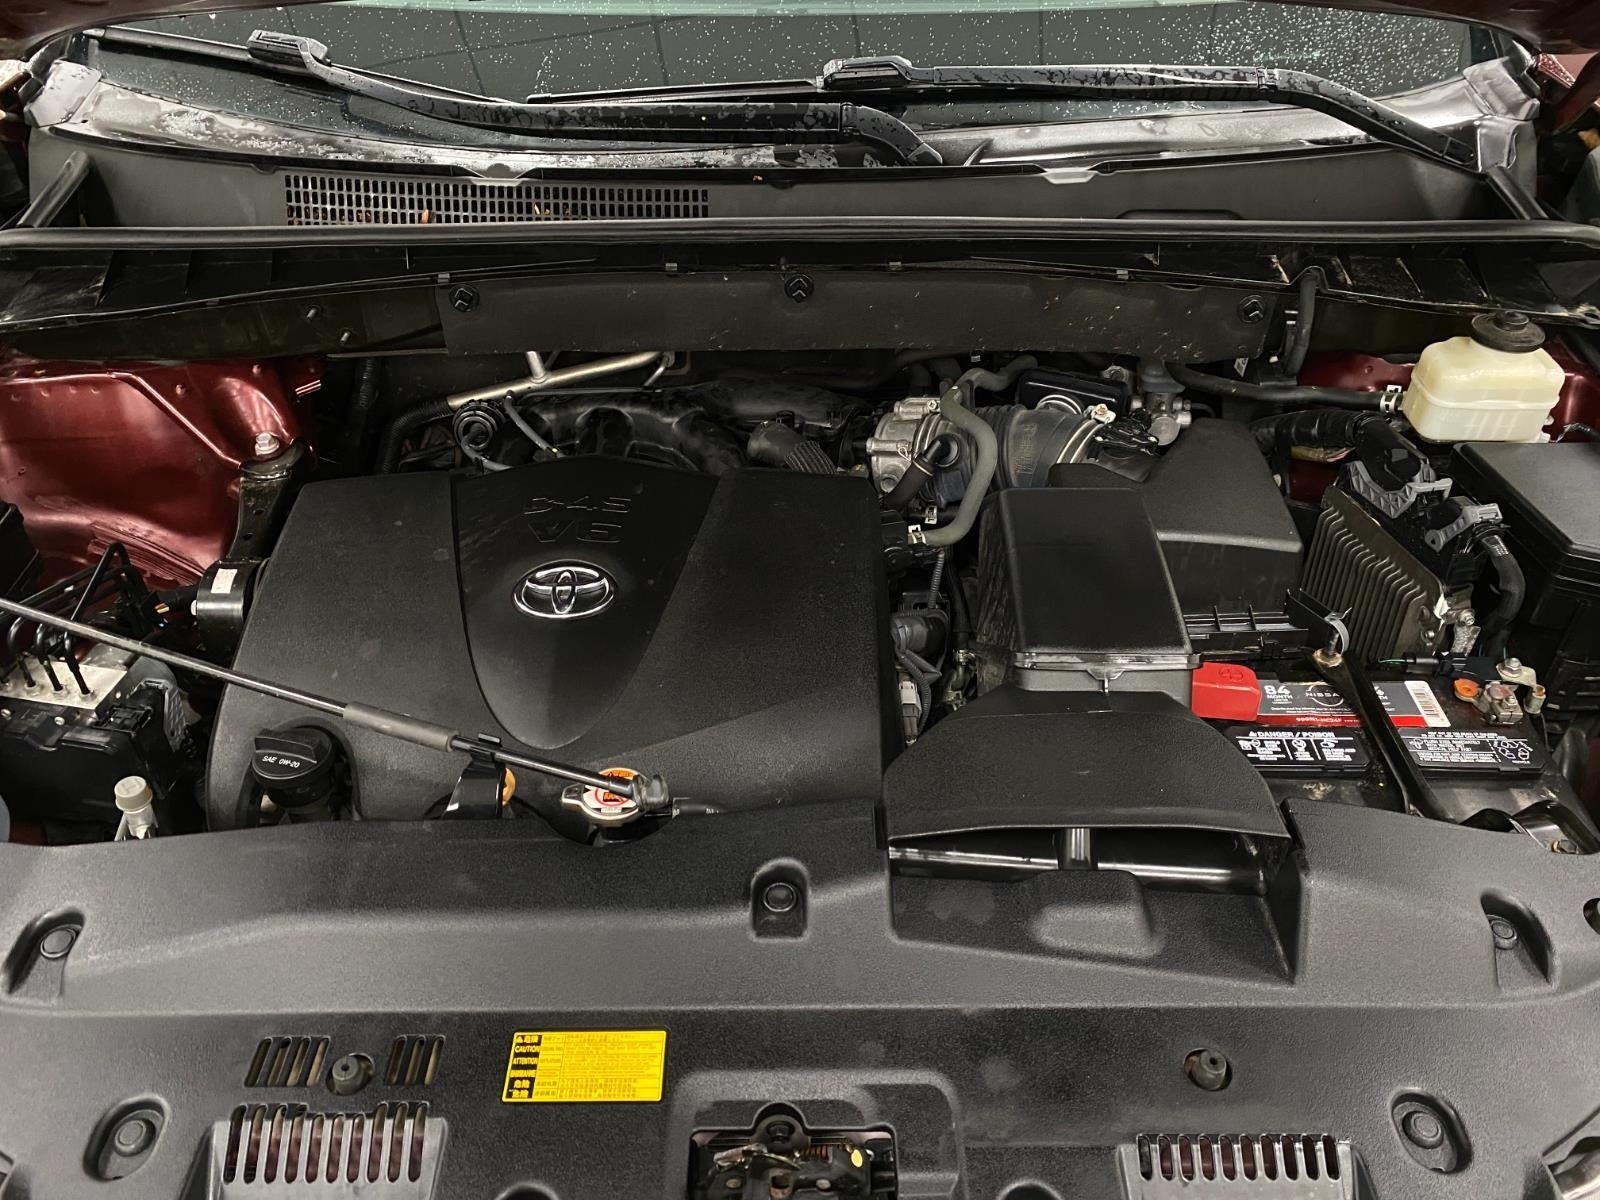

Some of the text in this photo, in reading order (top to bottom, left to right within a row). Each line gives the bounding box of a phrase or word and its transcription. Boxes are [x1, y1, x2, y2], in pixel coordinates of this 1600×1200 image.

[1263, 685, 1291, 695] 84
[1257, 731, 1294, 739] DANGER
[1302, 731, 1336, 739] POISON
[262, 755, 300, 768] SAE 0W-20
[514, 1045, 541, 1053] CAUTION
[512, 1057, 539, 1065] ATTENTION
